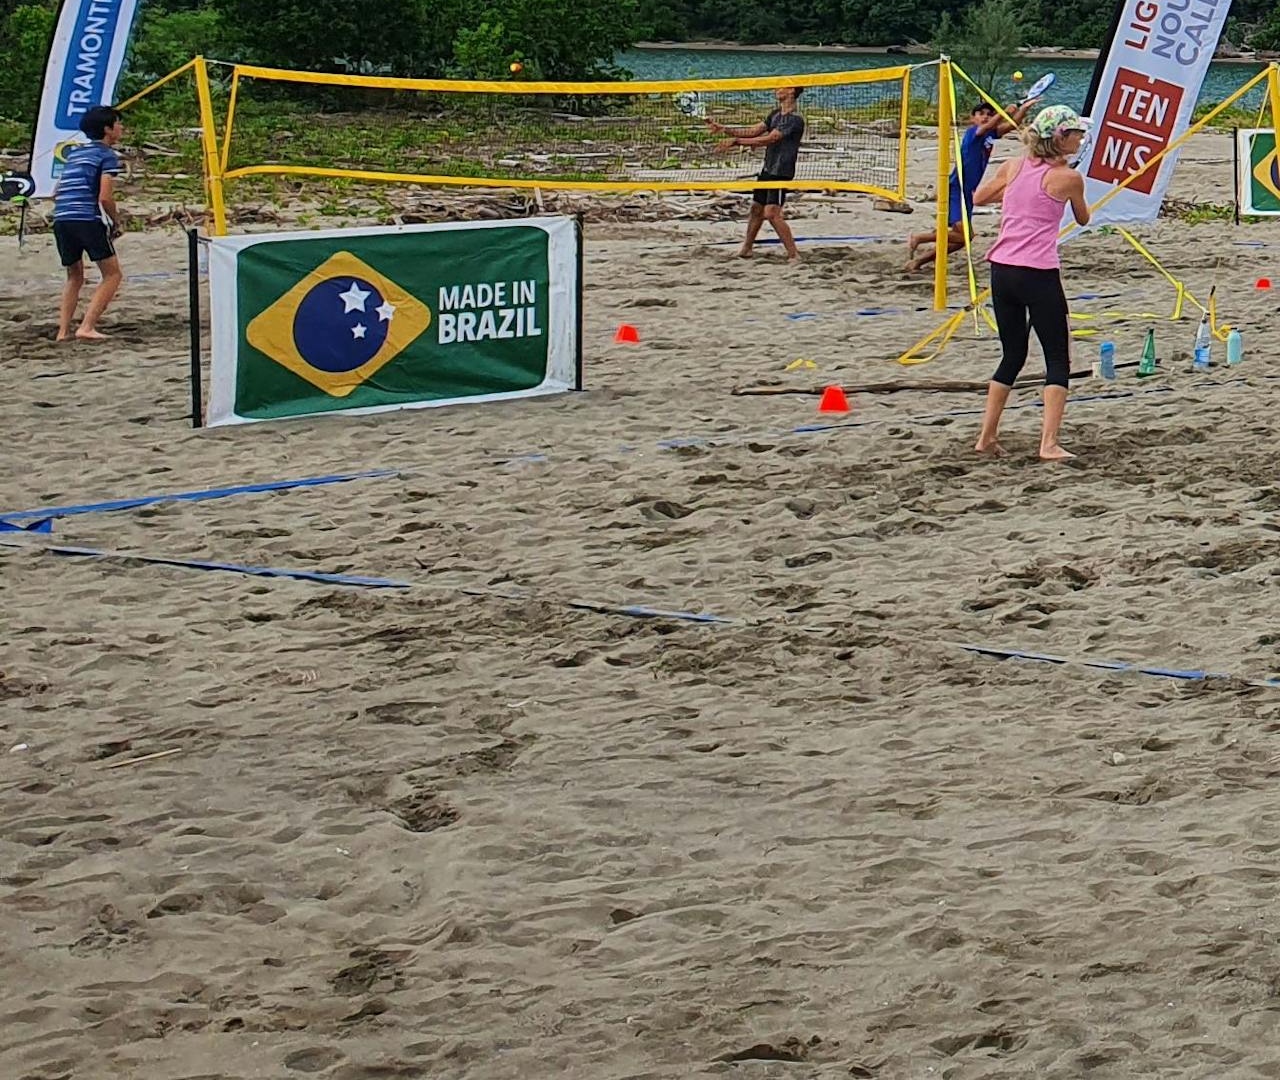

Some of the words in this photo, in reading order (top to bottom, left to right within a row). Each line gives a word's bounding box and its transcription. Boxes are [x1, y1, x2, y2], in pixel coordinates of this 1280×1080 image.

[1116, 84, 1169, 127] TEN
[439, 284, 507, 311] MADE
[512, 280, 536, 305] IN
[438, 307, 542, 345] BRAZIL
